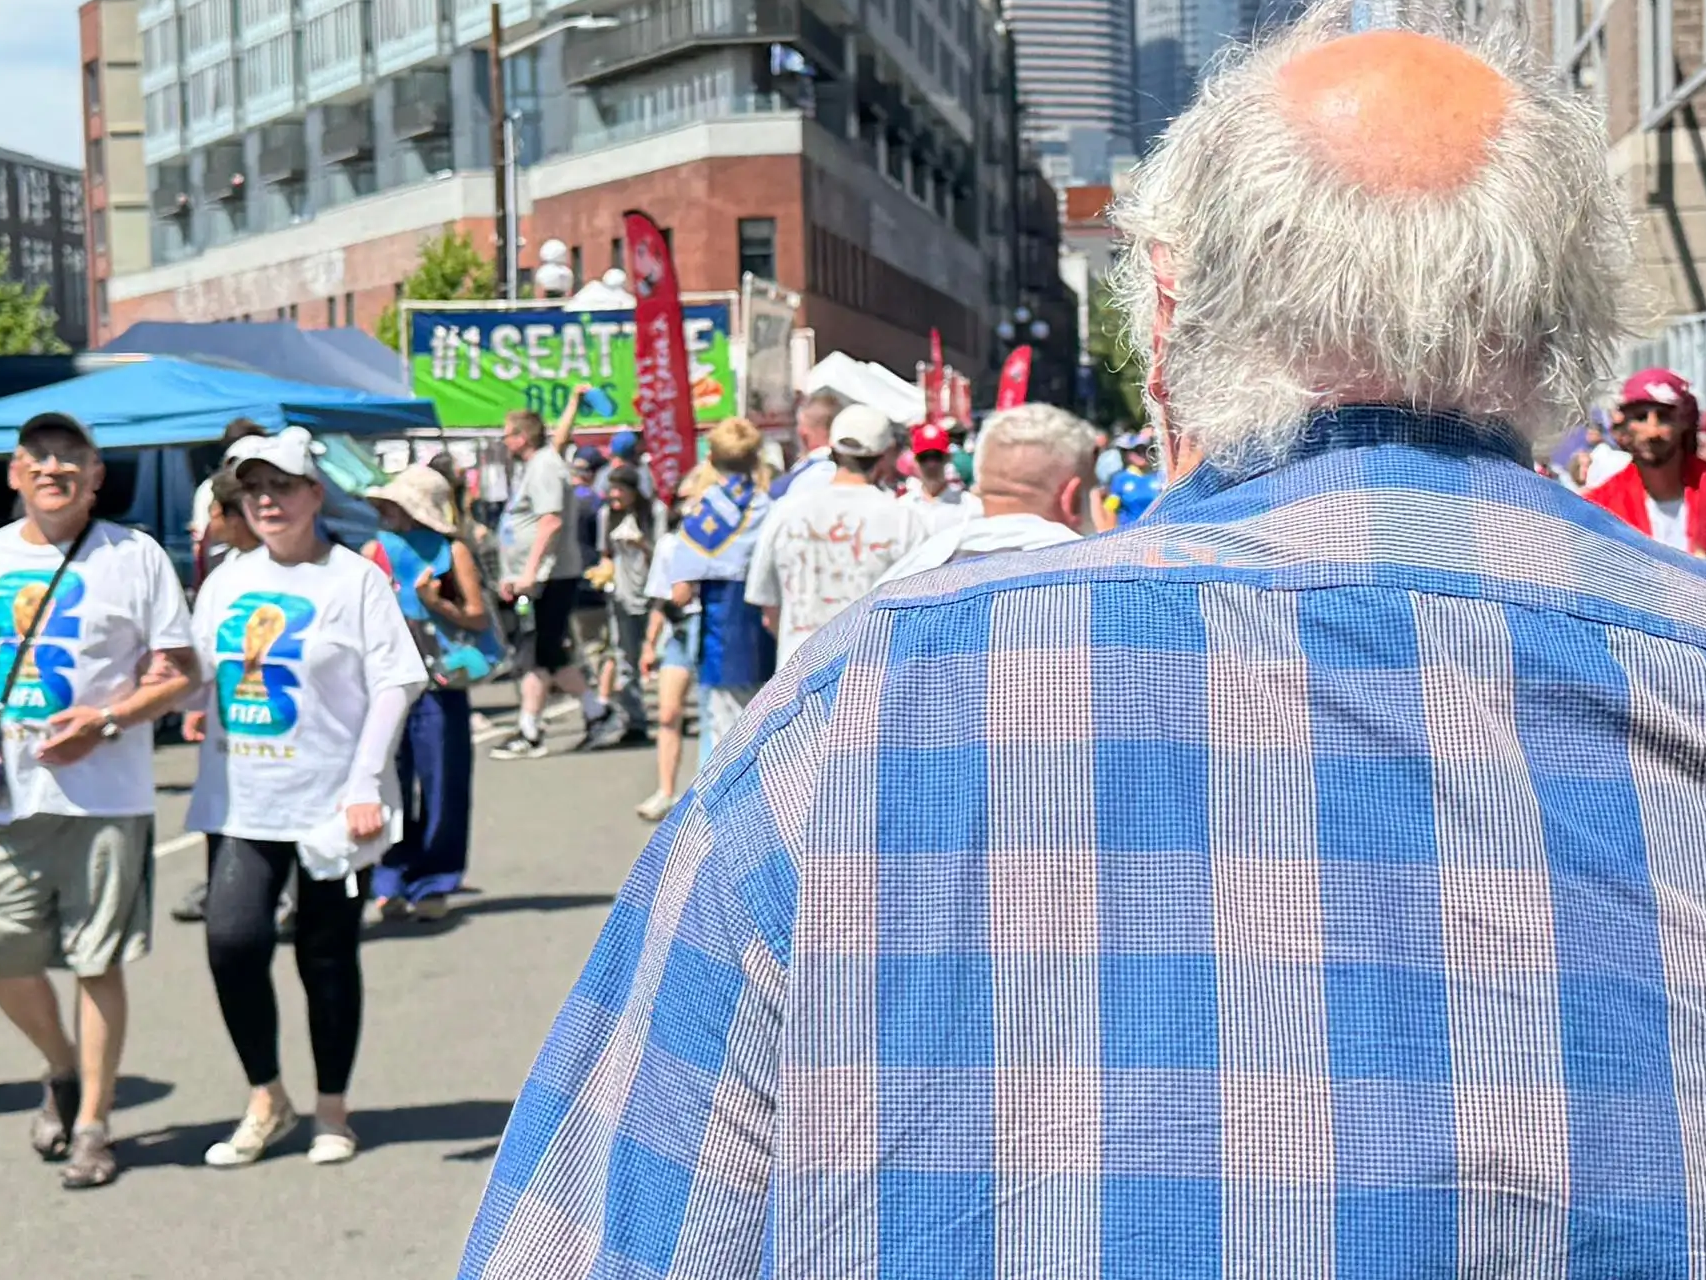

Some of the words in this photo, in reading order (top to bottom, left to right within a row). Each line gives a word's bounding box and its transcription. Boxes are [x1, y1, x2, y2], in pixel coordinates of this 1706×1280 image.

[431, 324, 481, 381] #1
[492, 318, 715, 382] SEATE
[228, 703, 273, 725] FIFA
